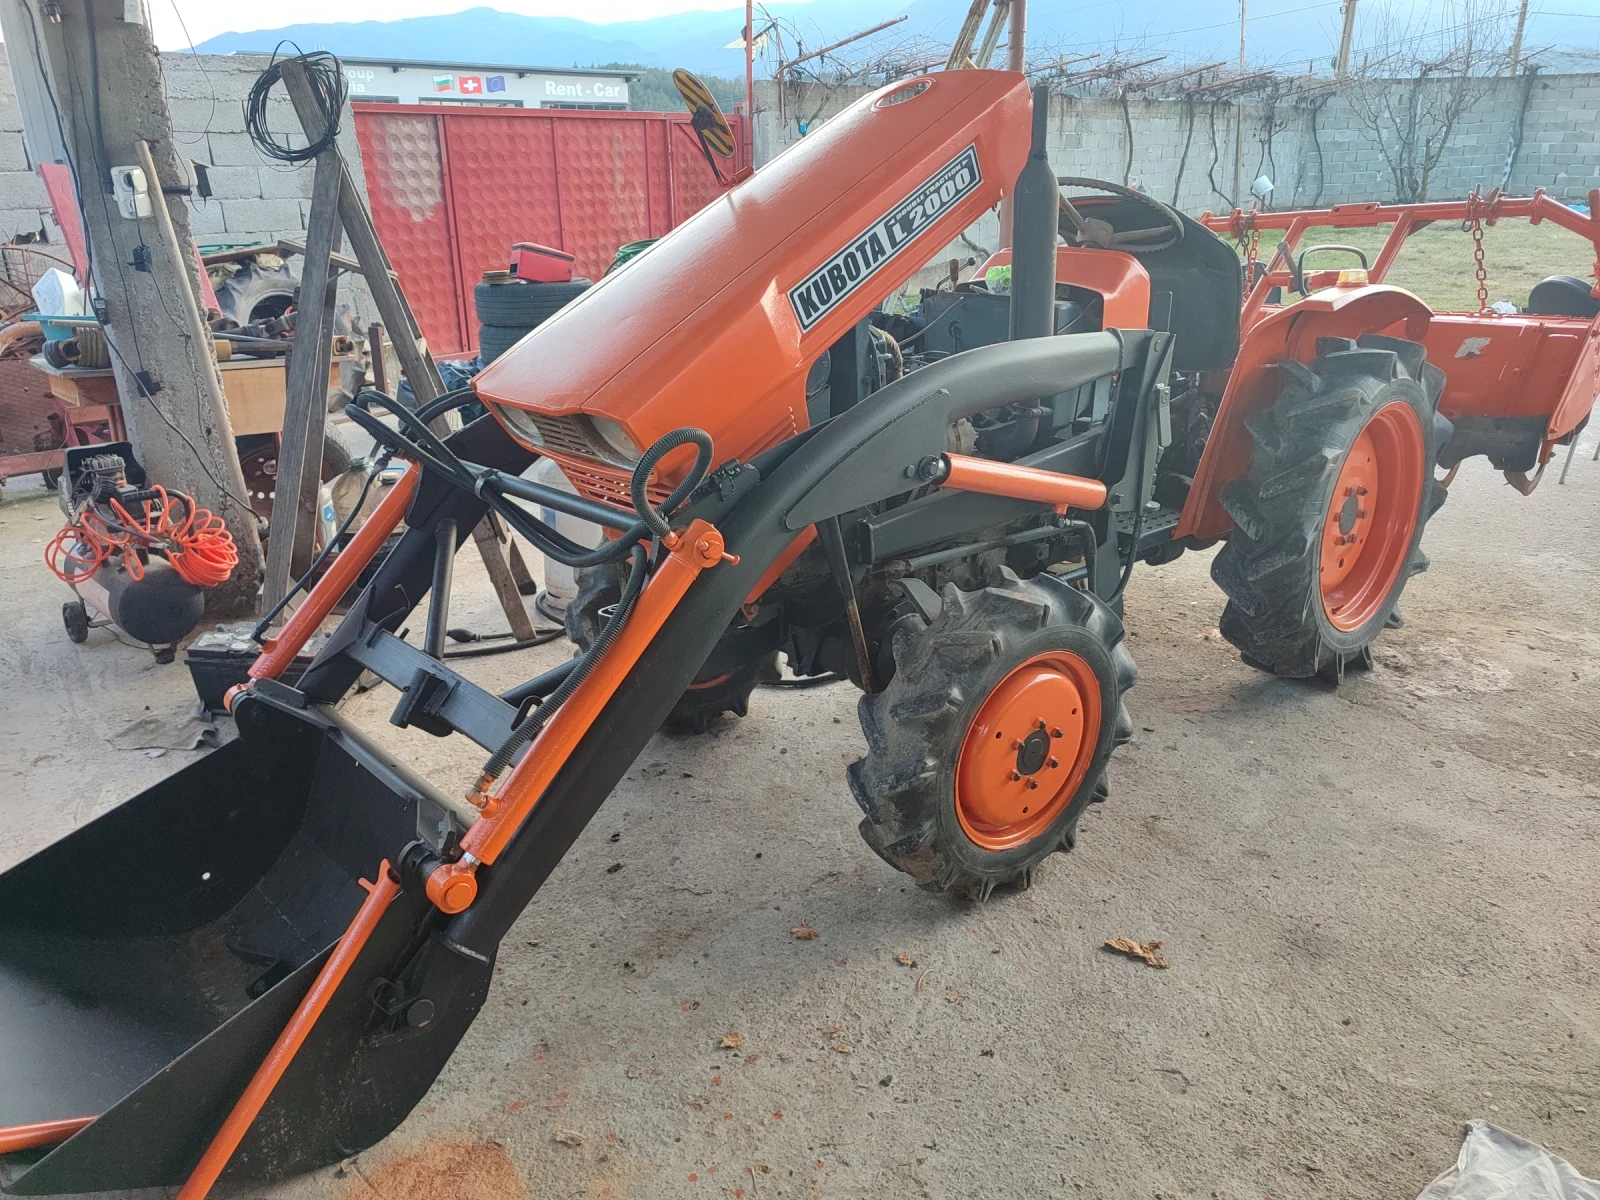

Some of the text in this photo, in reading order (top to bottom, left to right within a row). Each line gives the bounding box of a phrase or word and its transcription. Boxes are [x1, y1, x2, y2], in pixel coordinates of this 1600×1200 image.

[545, 80, 583, 97] Rent
[593, 82, 620, 97] Car
[896, 163, 962, 220] DOUBLE TRACTION
[797, 231, 887, 321] KUBOTA
